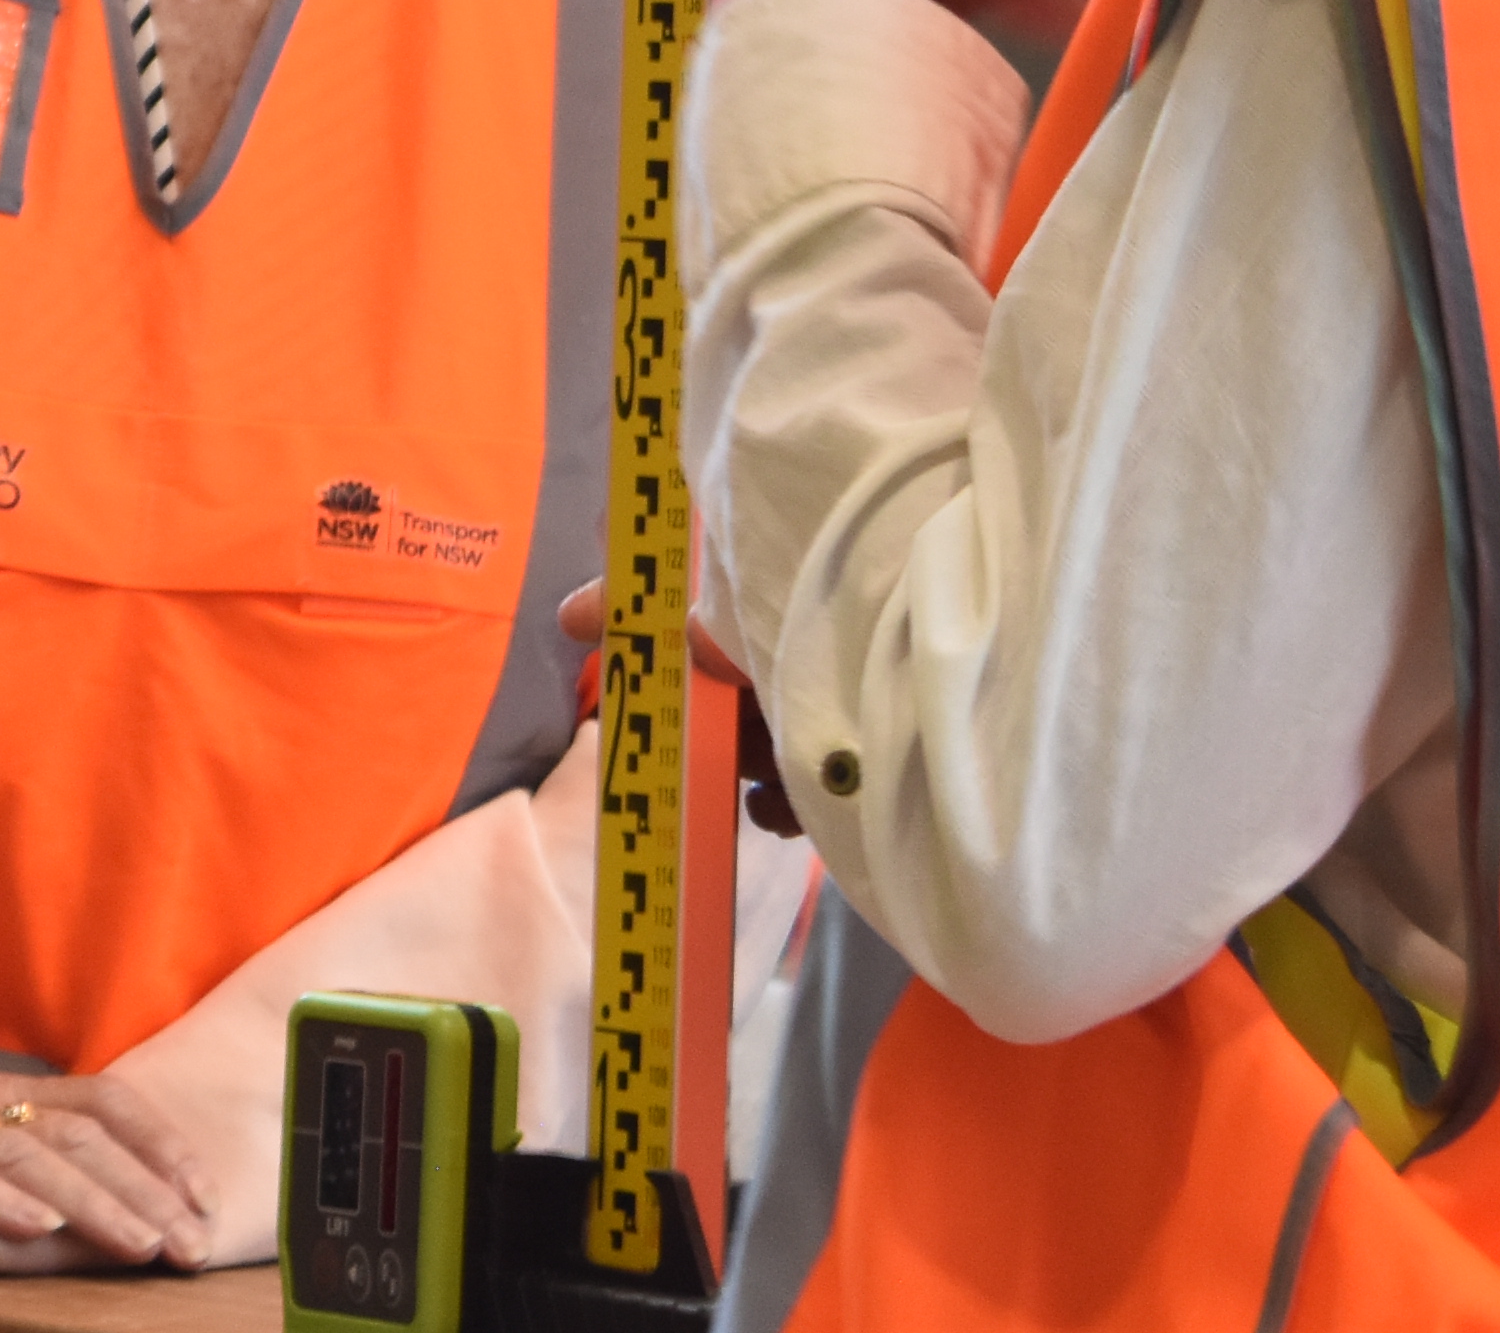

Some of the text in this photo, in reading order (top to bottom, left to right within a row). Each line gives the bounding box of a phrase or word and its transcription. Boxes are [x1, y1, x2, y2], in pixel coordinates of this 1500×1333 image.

[614, 258, 638, 422] 3
[317, 517, 379, 542] NSW
[400, 511, 499, 544] Transport
[397, 537, 428, 558] for
[434, 543, 483, 567] NSW
[602, 653, 627, 813] 2
